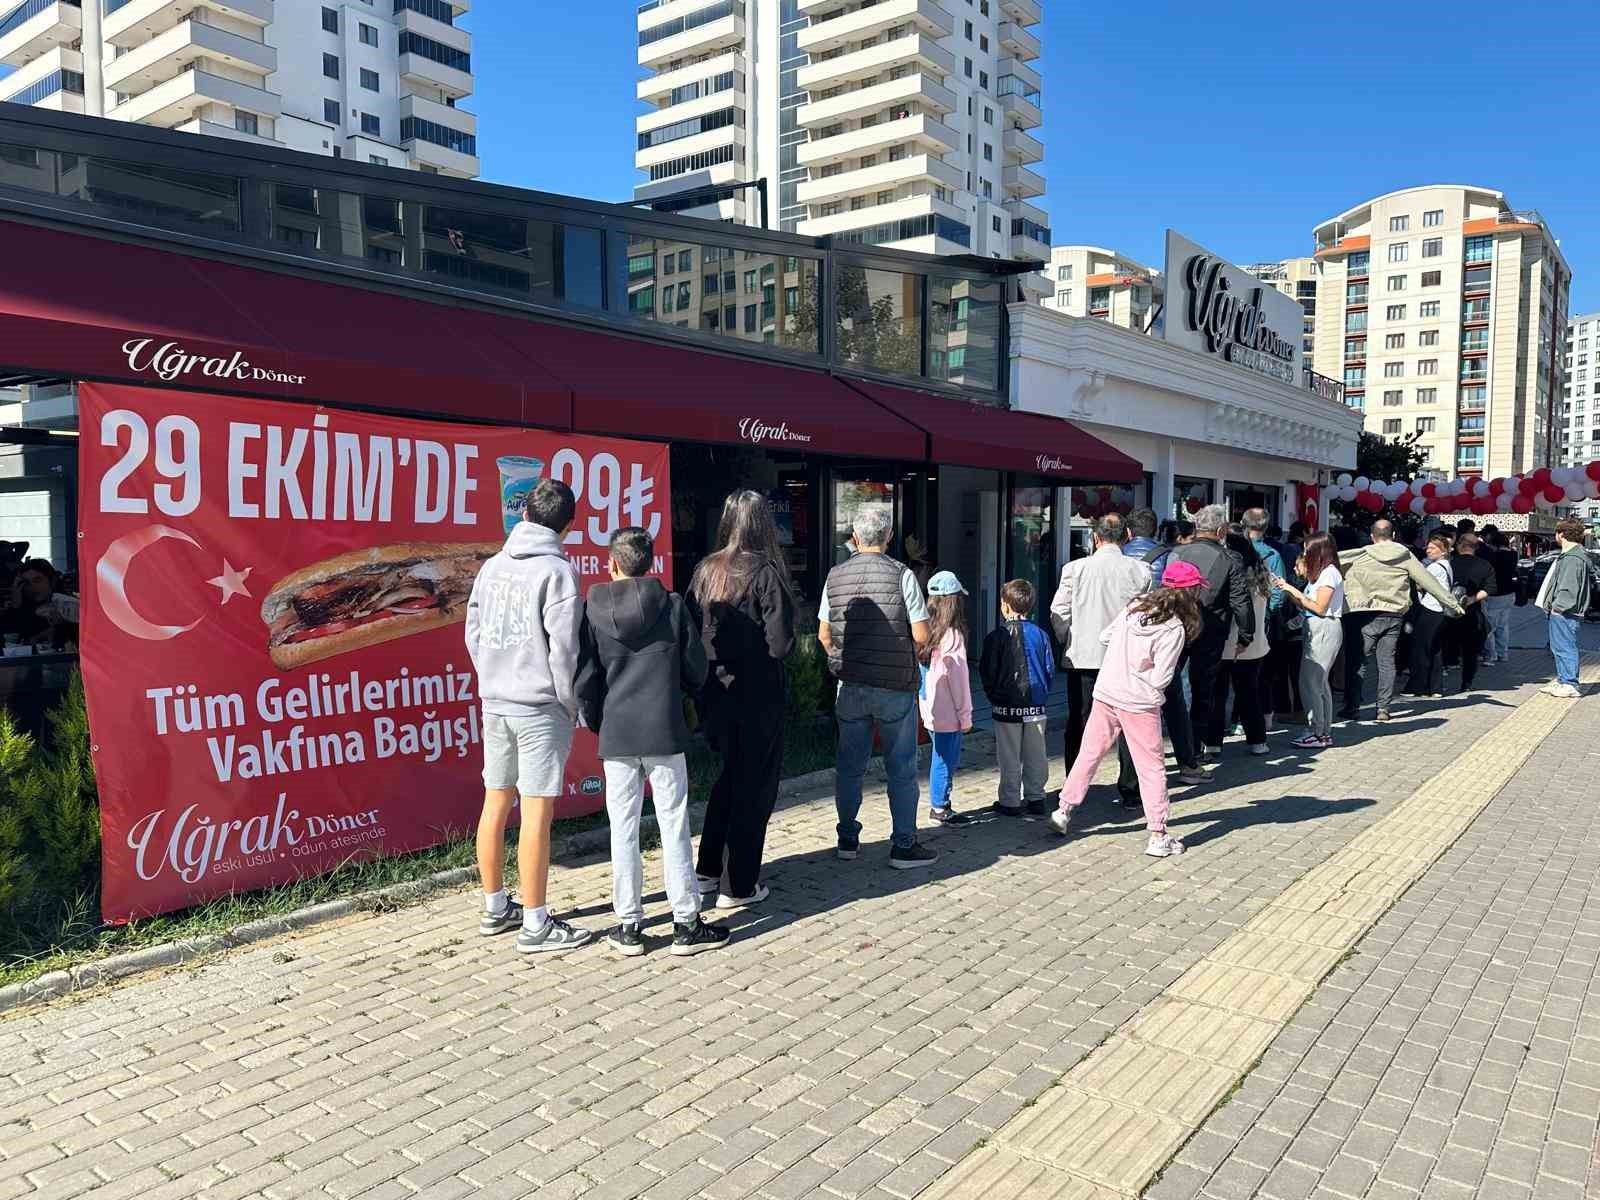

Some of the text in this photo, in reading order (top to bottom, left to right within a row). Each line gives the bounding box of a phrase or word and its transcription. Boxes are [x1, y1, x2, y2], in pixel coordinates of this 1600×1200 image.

[122, 338, 306, 385] Uğrak Döner
[739, 417, 789, 443] Uğrak
[100, 409, 201, 517] 29
[506, 497, 529, 512] Ayra
[564, 551, 600, 575] NER
[146, 663, 473, 736] Tüm Gelirlerimiz
[207, 705, 485, 783] Vakfına Bağışl
[127, 792, 379, 884] Uğrak Döner
[213, 854, 243, 875] eski
[291, 838, 328, 857] odun
